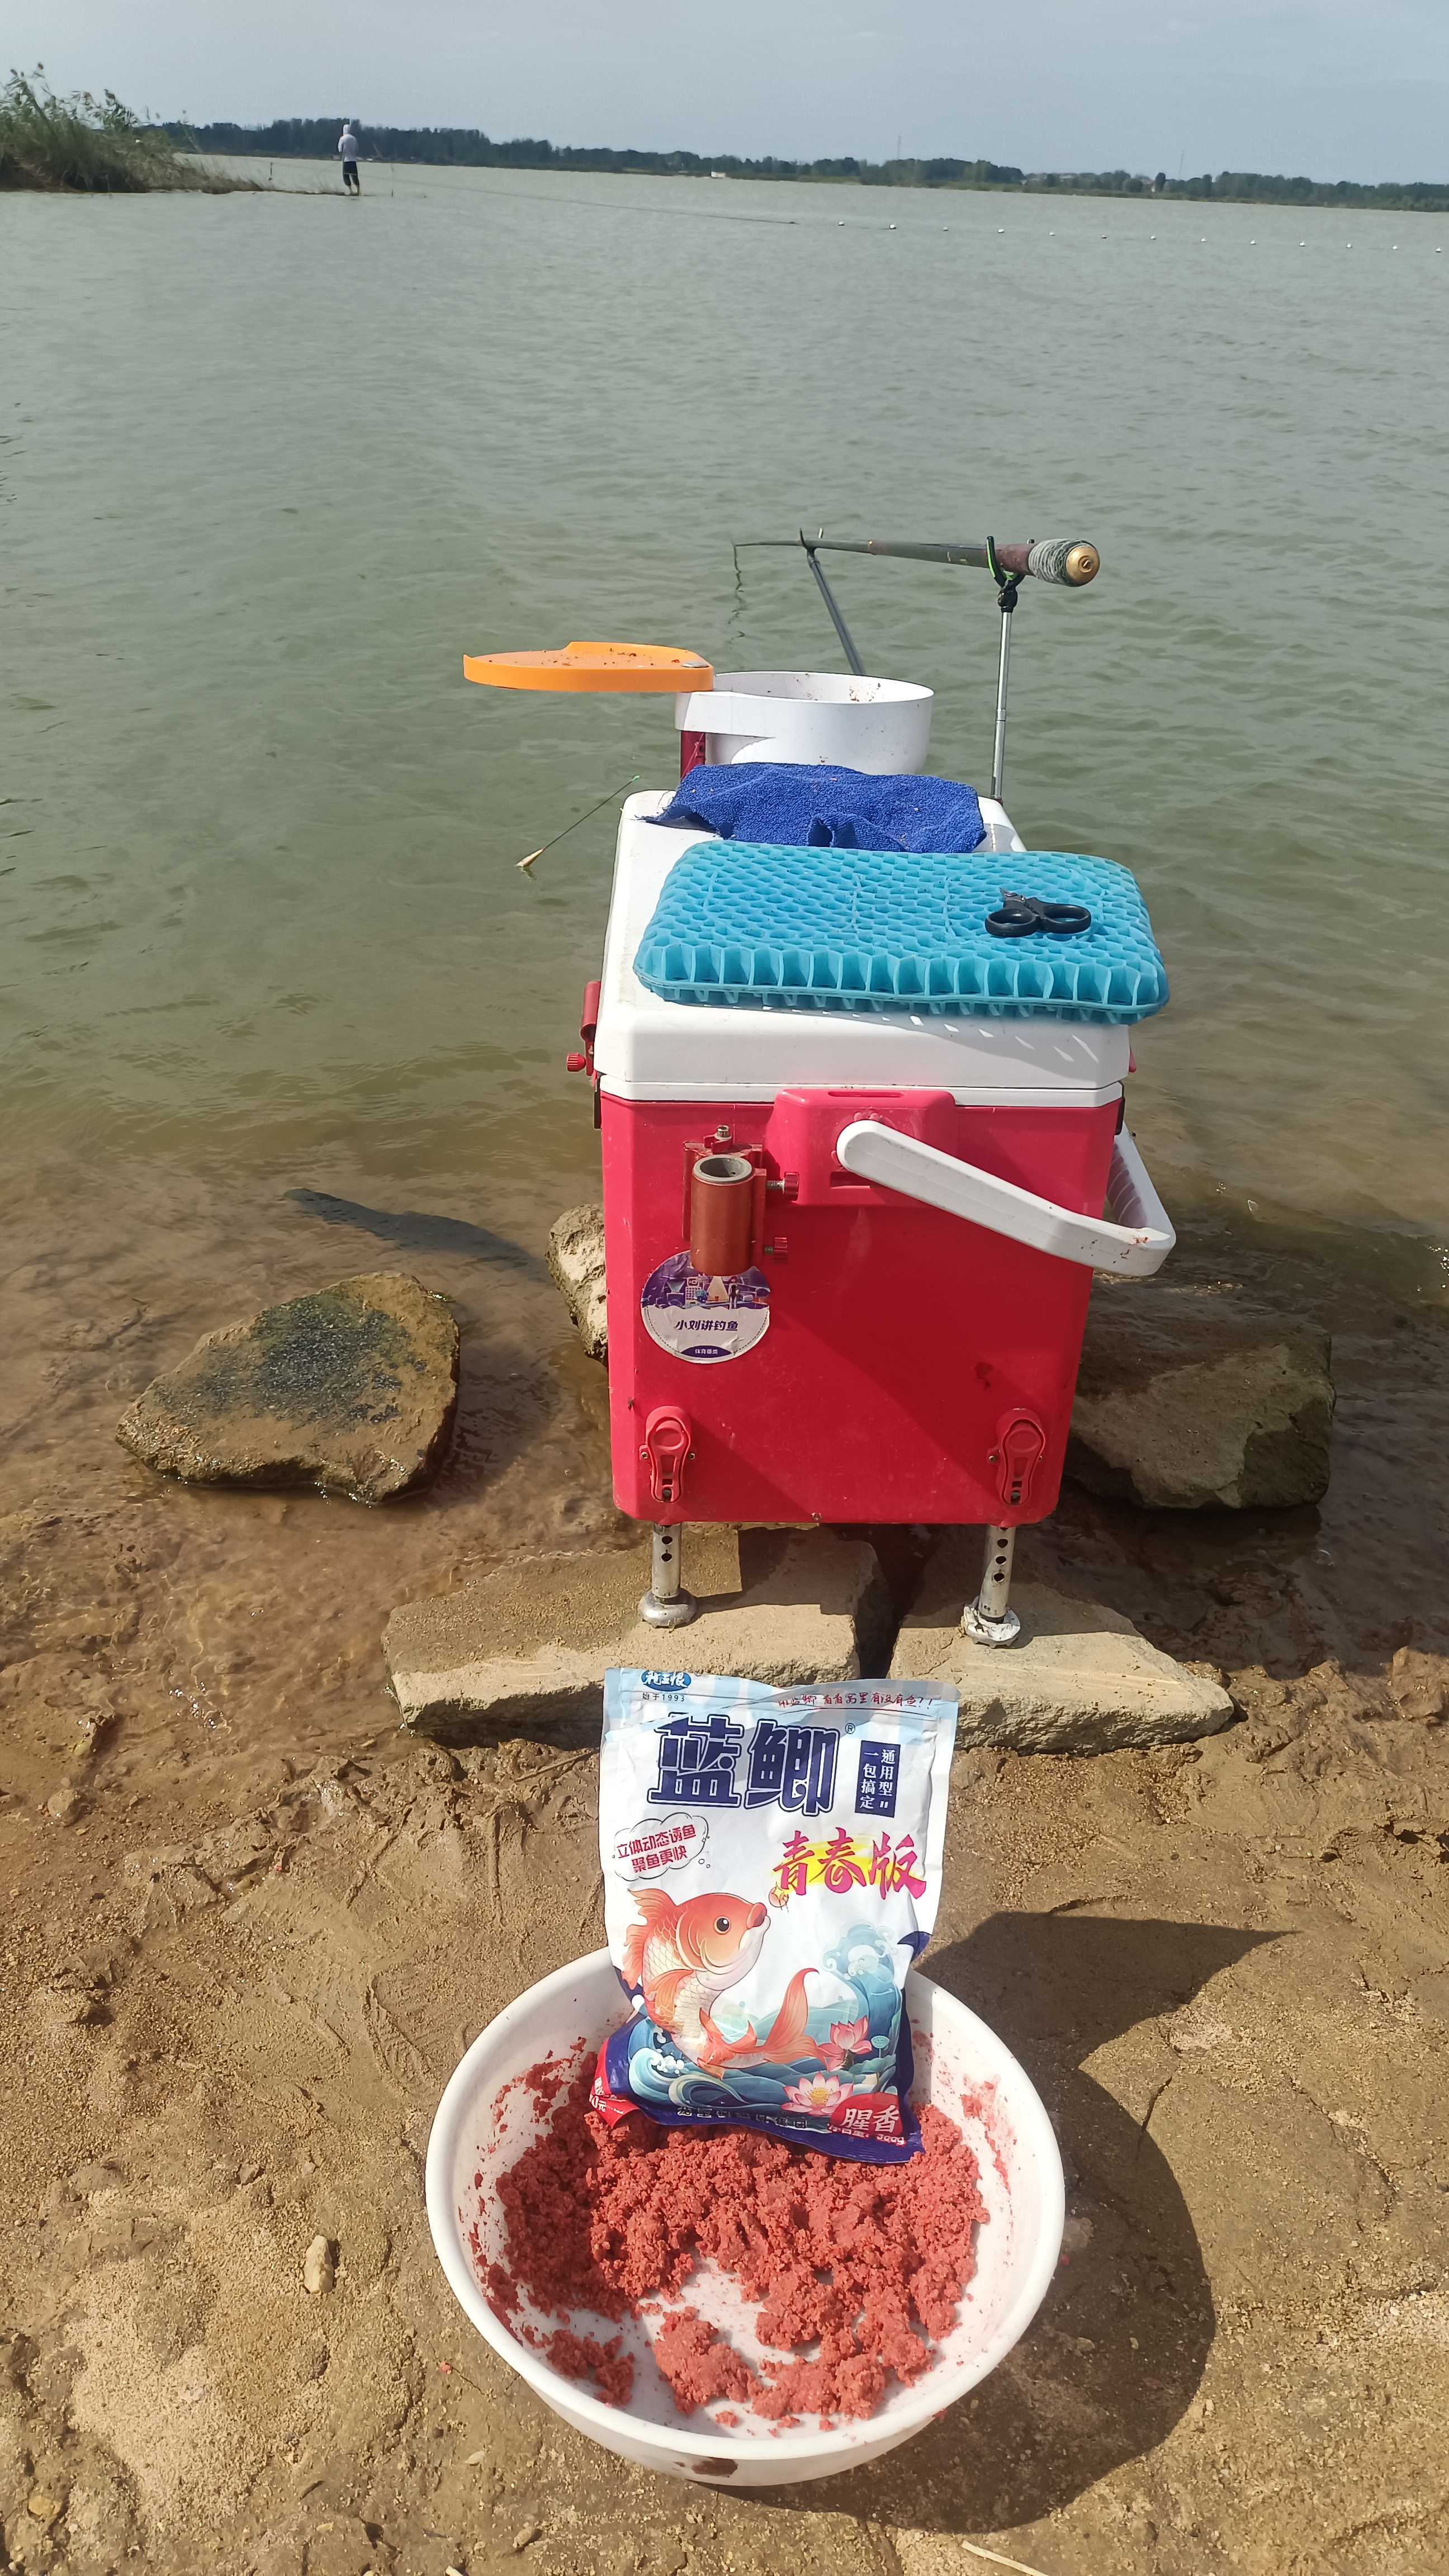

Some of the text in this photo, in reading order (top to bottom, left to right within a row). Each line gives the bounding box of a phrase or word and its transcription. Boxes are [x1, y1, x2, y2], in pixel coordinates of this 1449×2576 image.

[674, 1320, 738, 1331] 小刘讲钓鱼
[647, 1712, 841, 1816] 蓝鲫
[860, 1751, 879, 1809] 一包搞定
[616, 1824, 697, 1859] 立体动态诱鱼
[631, 1845, 688, 1873] 聚鱼更快
[773, 1827, 927, 1900] 青春版
[841, 2105, 899, 2133] 腥香
